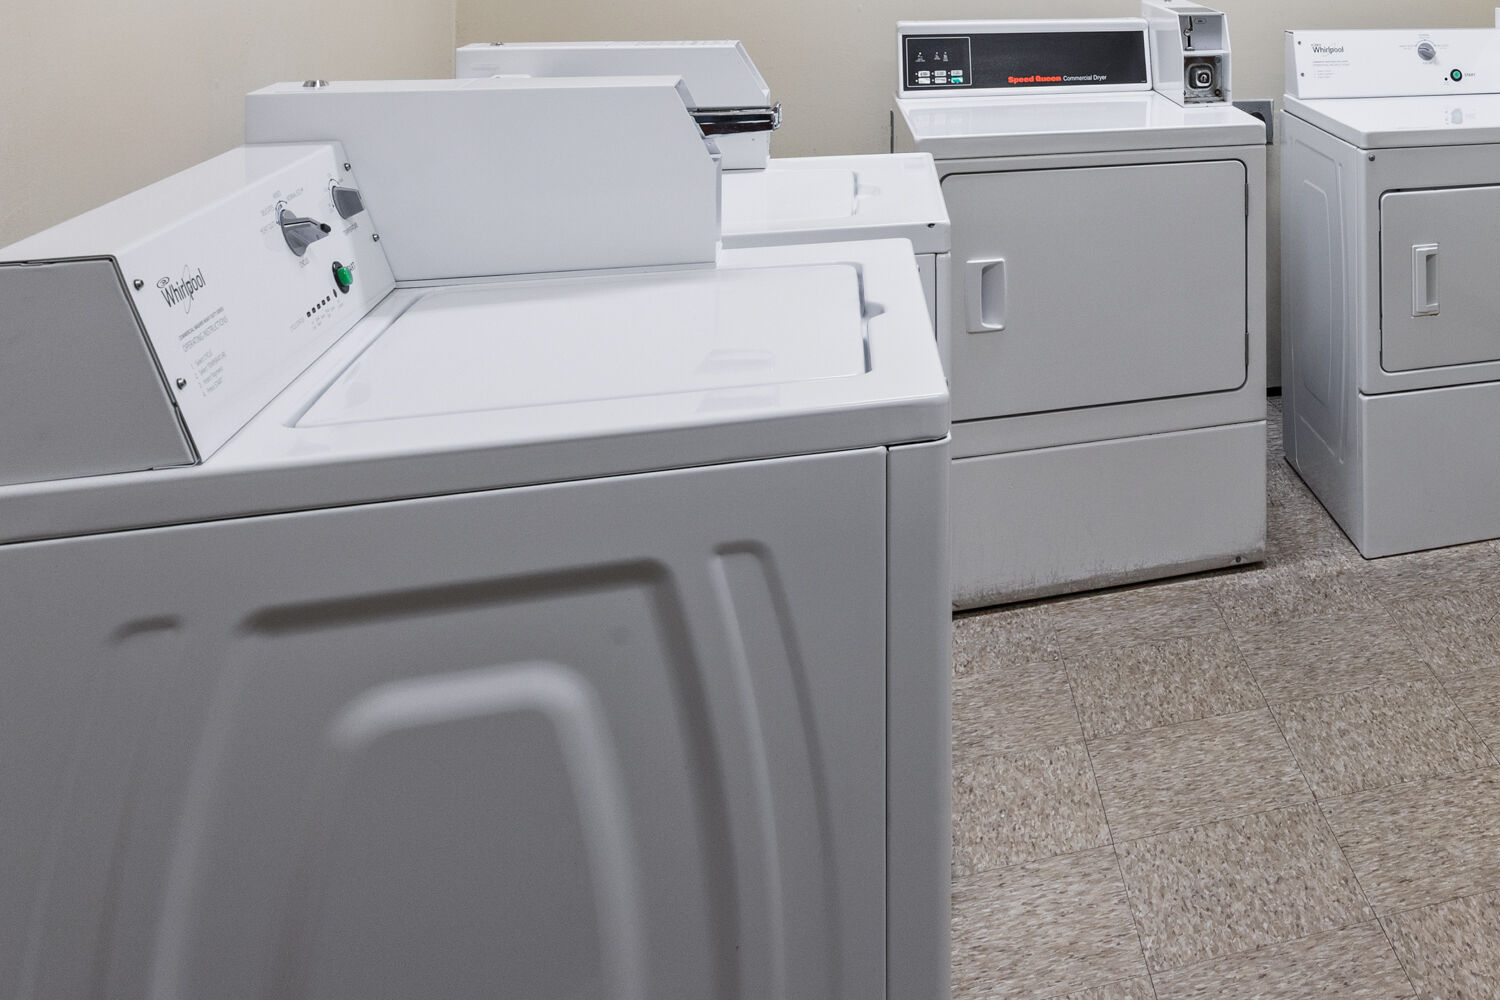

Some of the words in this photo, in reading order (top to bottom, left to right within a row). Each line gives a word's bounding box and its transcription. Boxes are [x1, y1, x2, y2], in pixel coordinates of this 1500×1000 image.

[1312, 46, 1344, 55] Whirlpool
[1007, 75, 1035, 85] Speed
[1035, 74, 1062, 83] Queen
[1062, 74, 1093, 82] Commercial
[1093, 74, 1107, 82] Dryer
[160, 267, 206, 308] Whirlpool
